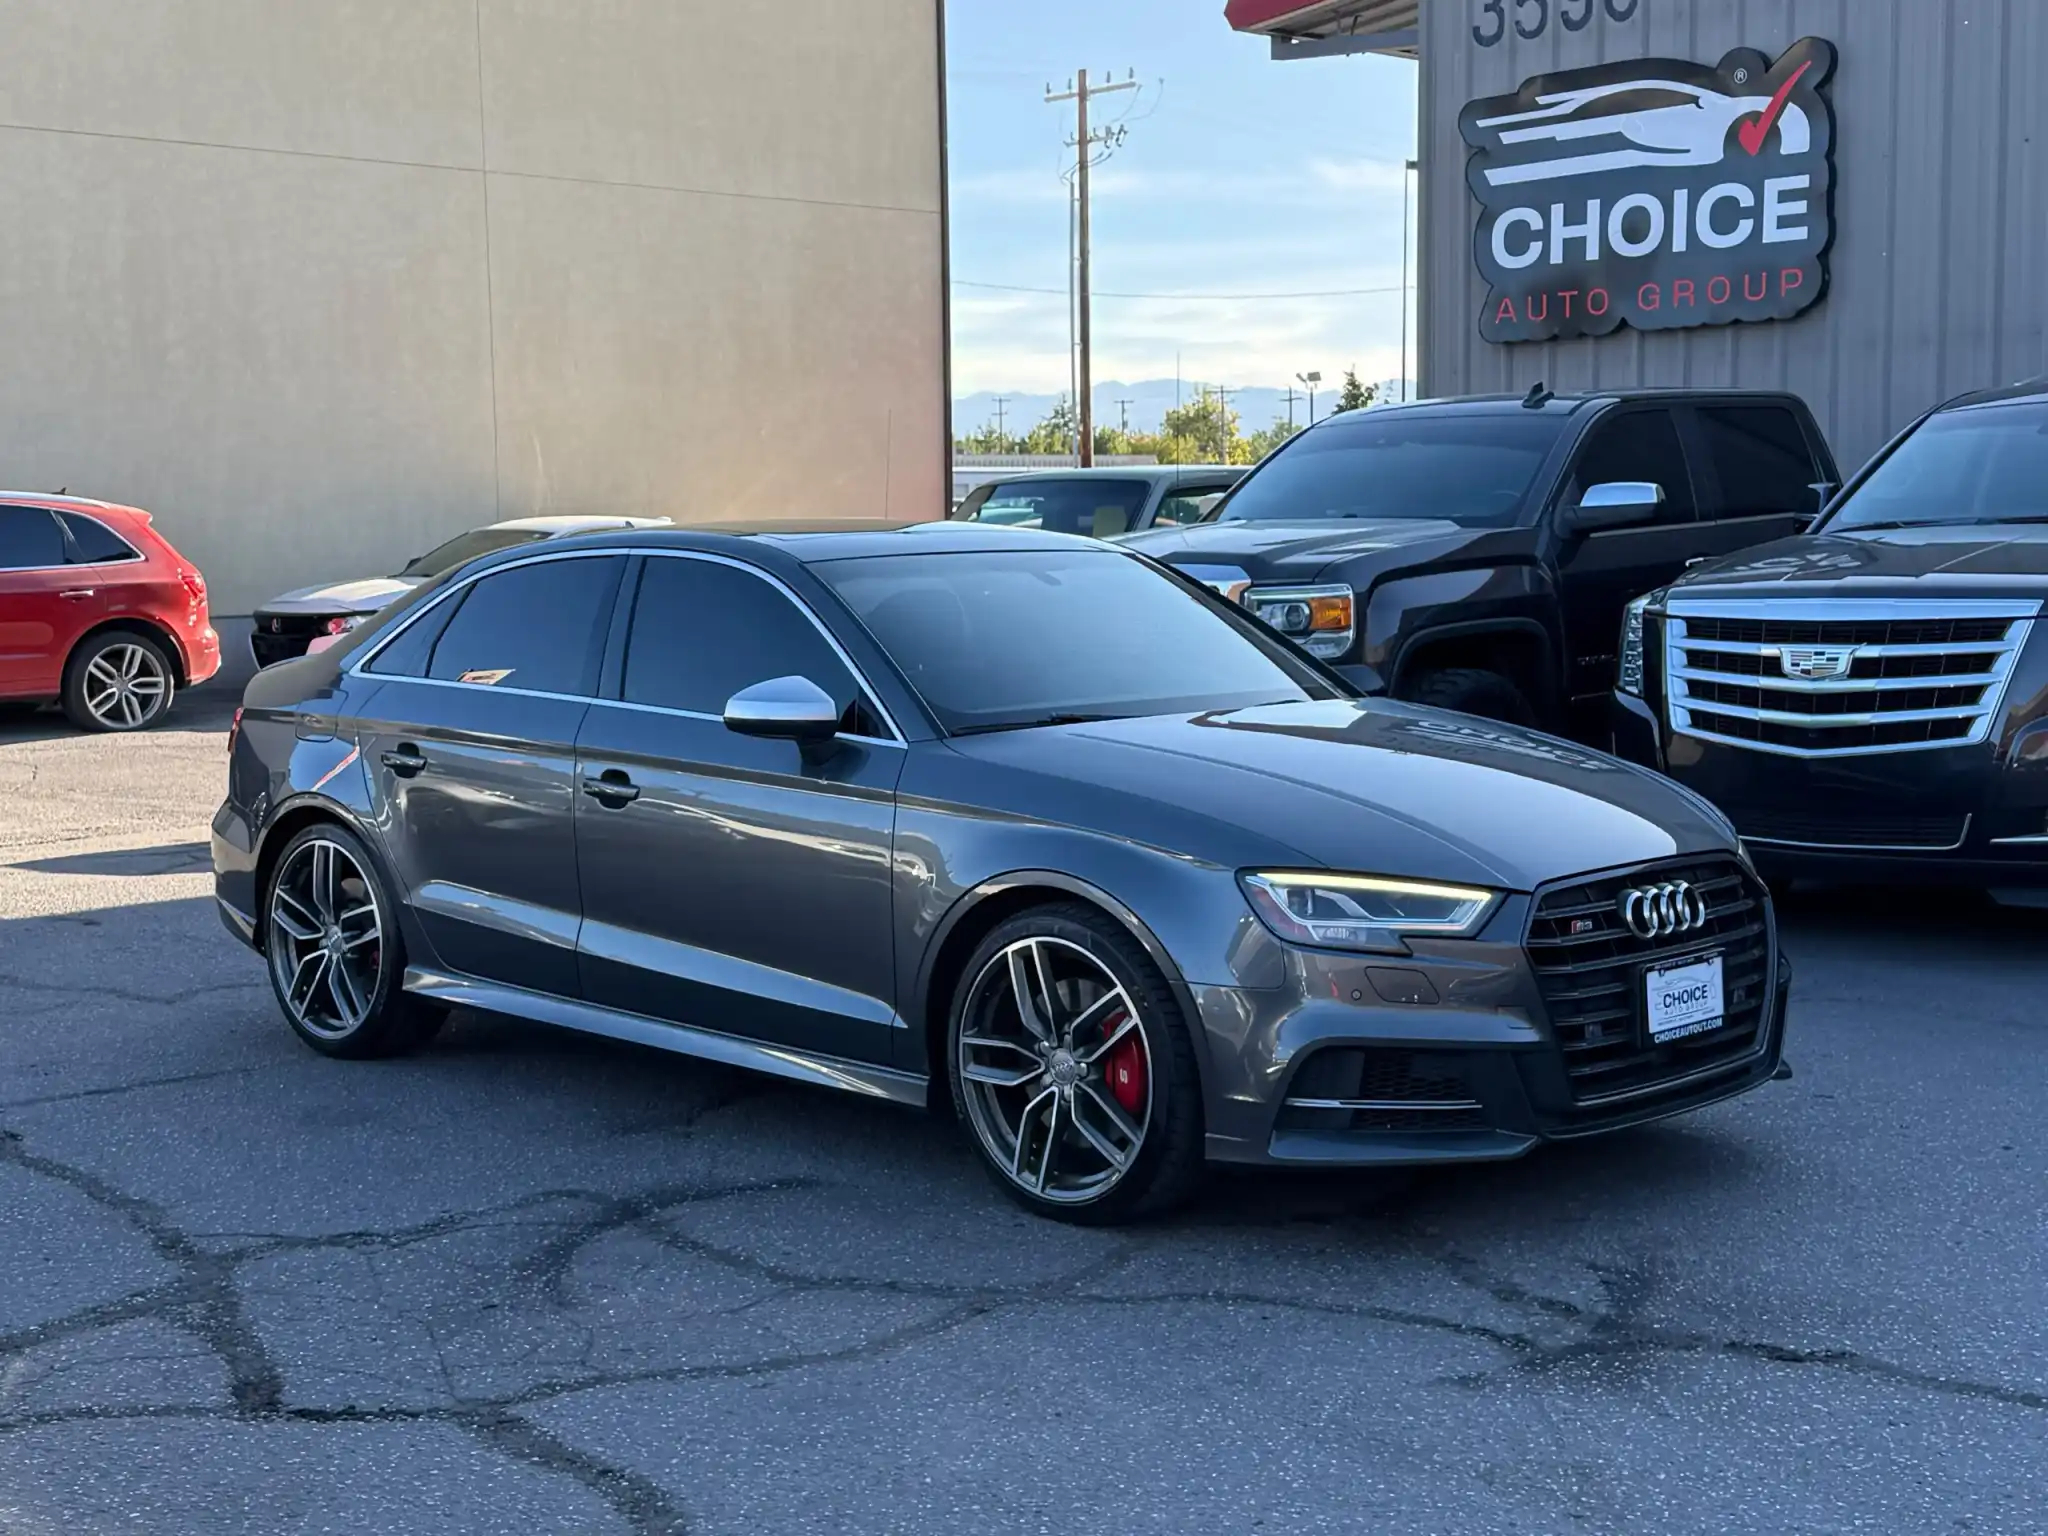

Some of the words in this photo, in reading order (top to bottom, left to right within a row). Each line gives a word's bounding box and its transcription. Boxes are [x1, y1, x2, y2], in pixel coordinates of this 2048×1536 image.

[1491, 174, 1810, 269] CHOICE
[1495, 288, 1610, 324] AUTO
[1637, 268, 1804, 311] GROUP
[1663, 984, 1708, 1009] CHOICE
